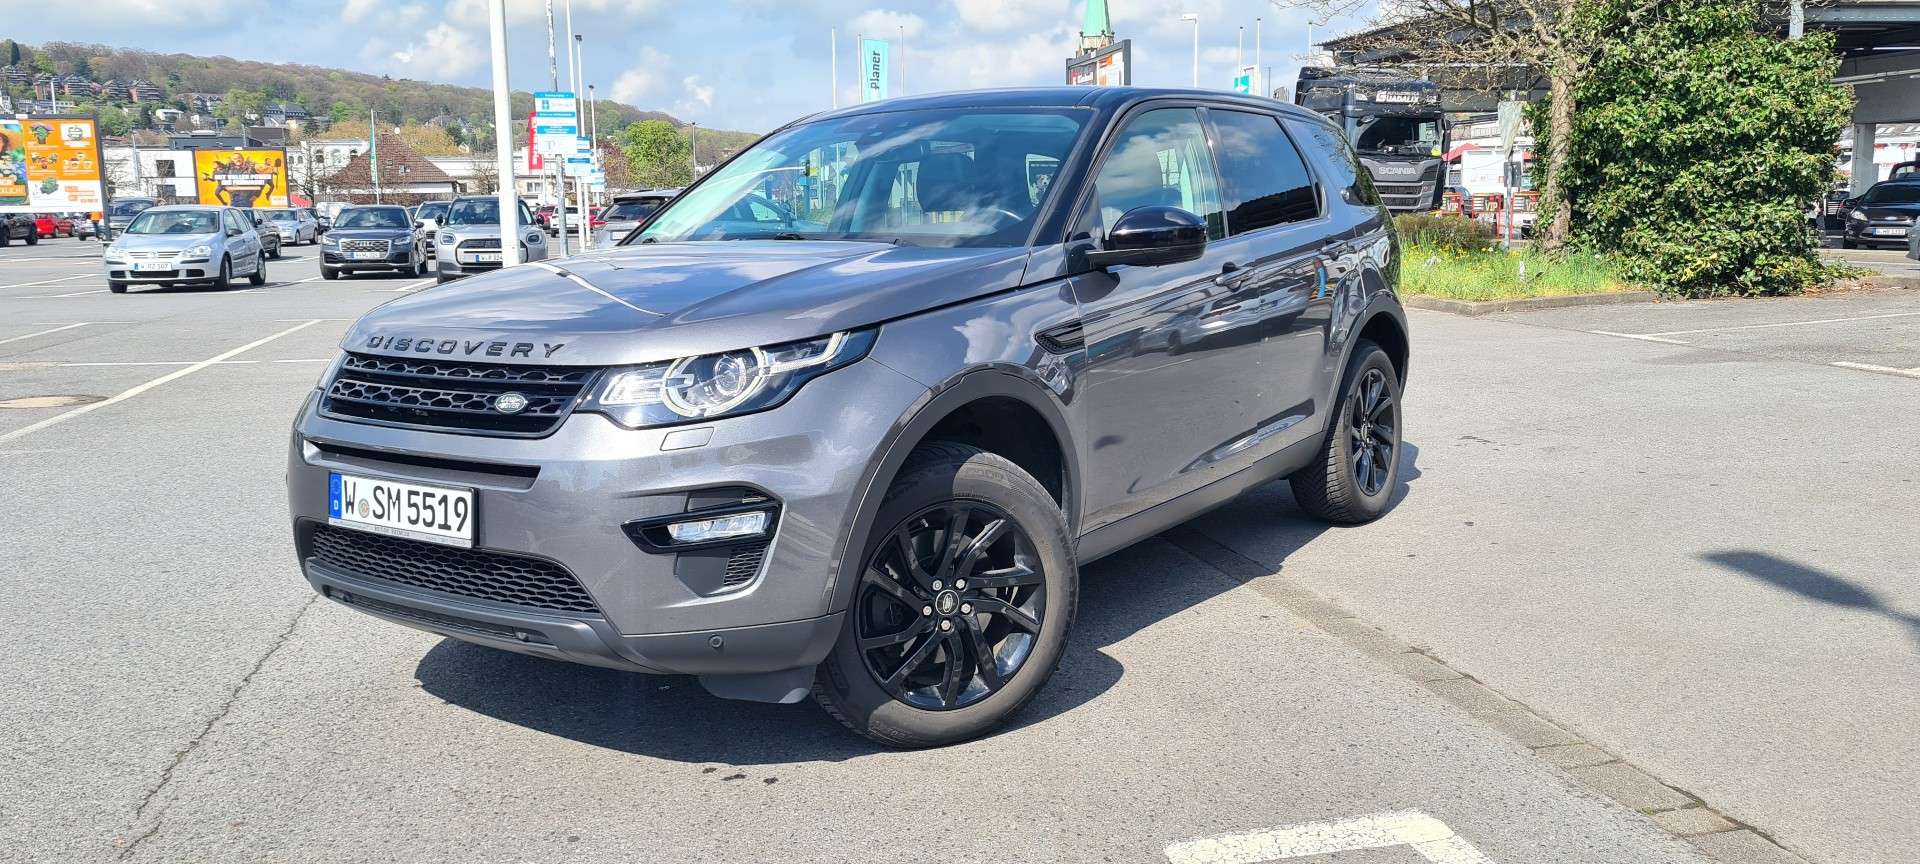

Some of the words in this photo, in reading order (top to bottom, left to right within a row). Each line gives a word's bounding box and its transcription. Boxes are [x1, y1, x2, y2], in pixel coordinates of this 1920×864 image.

[869, 50, 881, 90] Planer
[1379, 167, 1416, 175] SCANIA
[1485, 200, 1499, 211] VIP
[366, 335, 565, 358] DISCOVERY
[343, 479, 356, 515] W
[372, 485, 401, 523] SM
[407, 490, 468, 532] 5519
